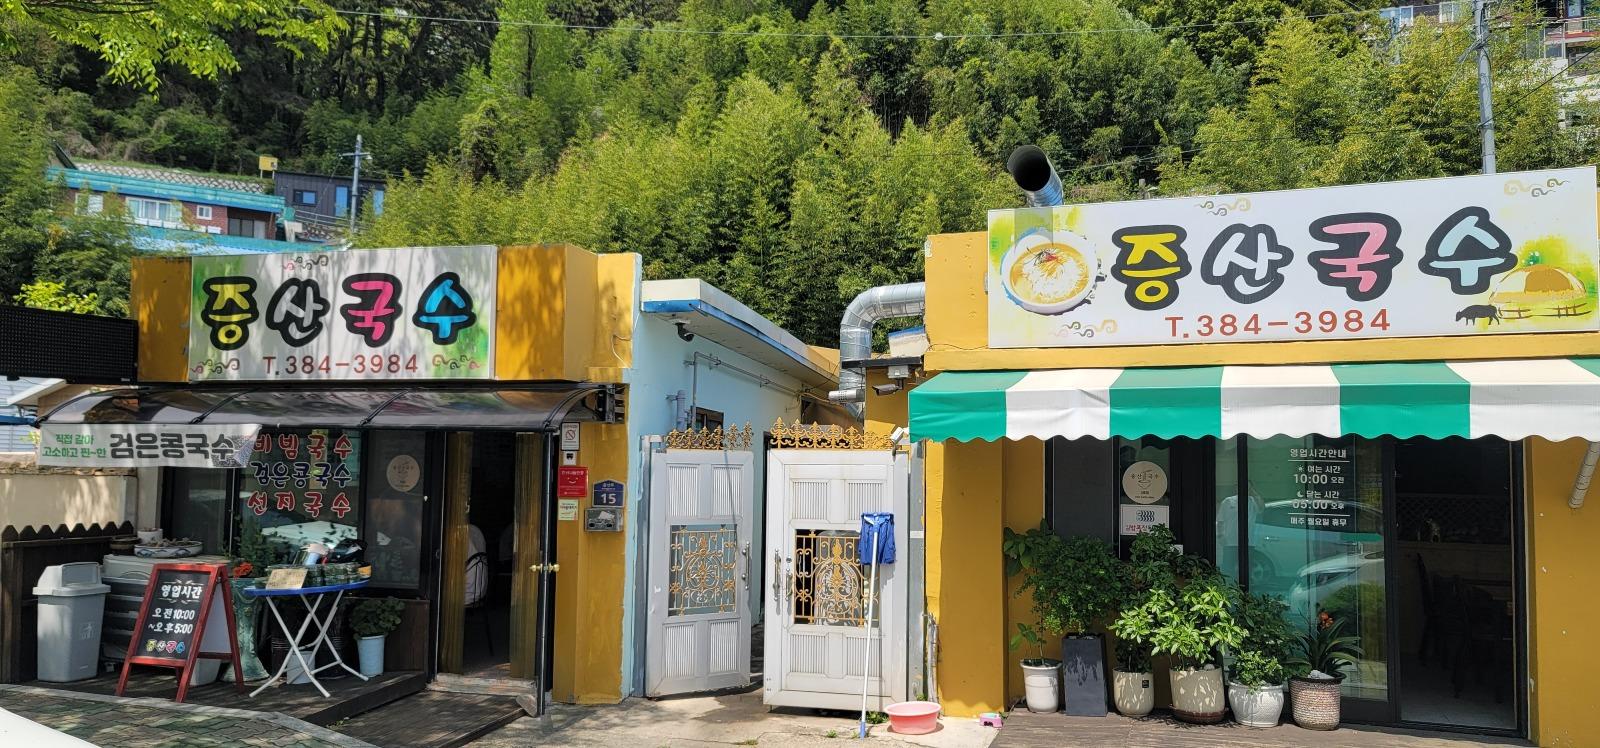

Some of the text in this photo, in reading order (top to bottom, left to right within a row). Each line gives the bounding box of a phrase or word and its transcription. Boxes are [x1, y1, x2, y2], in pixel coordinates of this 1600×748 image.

[1110, 206, 1518, 310] 증산국수
[200, 272, 476, 351] 증산국수
[109, 432, 235, 460] 검은콩국수
[253, 433, 354, 459] 비빔국수
[250, 461, 352, 488] 검은콩국수
[1325, 465, 1341, 474] 시간
[1294, 473, 1345, 484] 10:00 오전
[601, 493, 617, 504] 15
[1324, 490, 1340, 499] 시간
[247, 490, 352, 518] 선지국수
[1292, 498, 1328, 510] 05:00
[1290, 517, 1305, 525] 매주
[1307, 517, 1330, 526] 월요일
[161, 585, 203, 599] 영업시간
